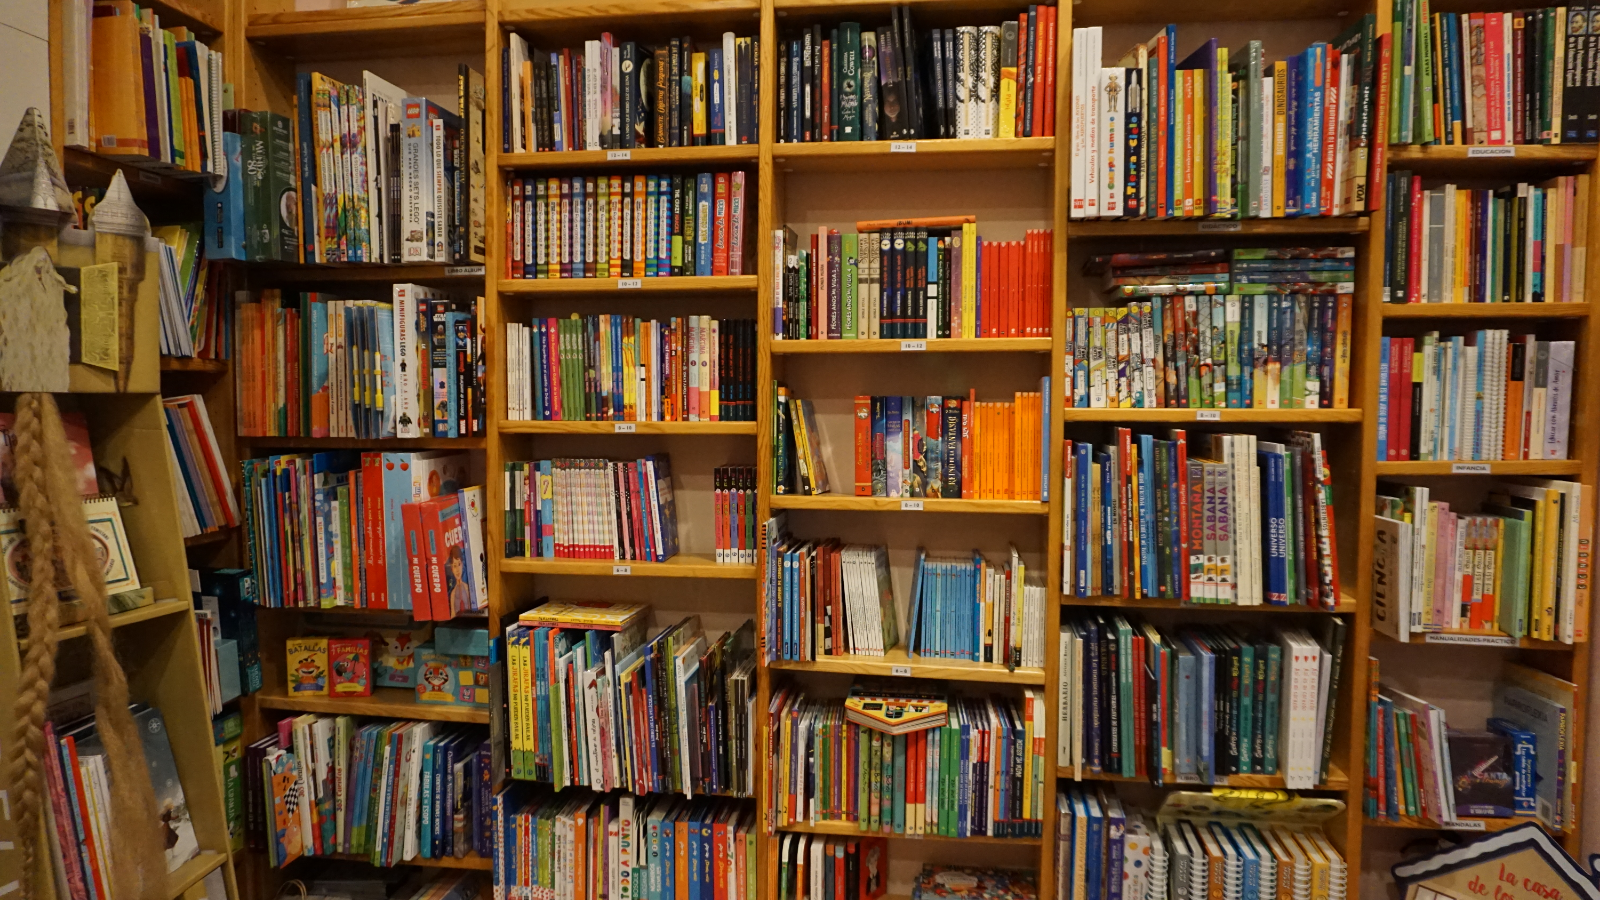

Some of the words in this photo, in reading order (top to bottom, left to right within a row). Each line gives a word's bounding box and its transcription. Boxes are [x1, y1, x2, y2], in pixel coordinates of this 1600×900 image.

[1313, 91, 1321, 153] HERRAMIENTAS
[1356, 184, 1365, 202] VOX
[1191, 483, 1202, 550] MONTAÑA
[1206, 486, 1215, 540] SABANA
[1218, 487, 1229, 541] SABANA
[413, 565, 422, 593] CUERPO
[431, 565, 441, 592] CUERPO
[288, 645, 326, 655] BATALLAS
[337, 646, 369, 655] FAMILIAS
[620, 819, 632, 857] PUNTO
[620, 869, 632, 899] TODO
[1468, 875, 1489, 896] de
[1499, 863, 1519, 887] La
